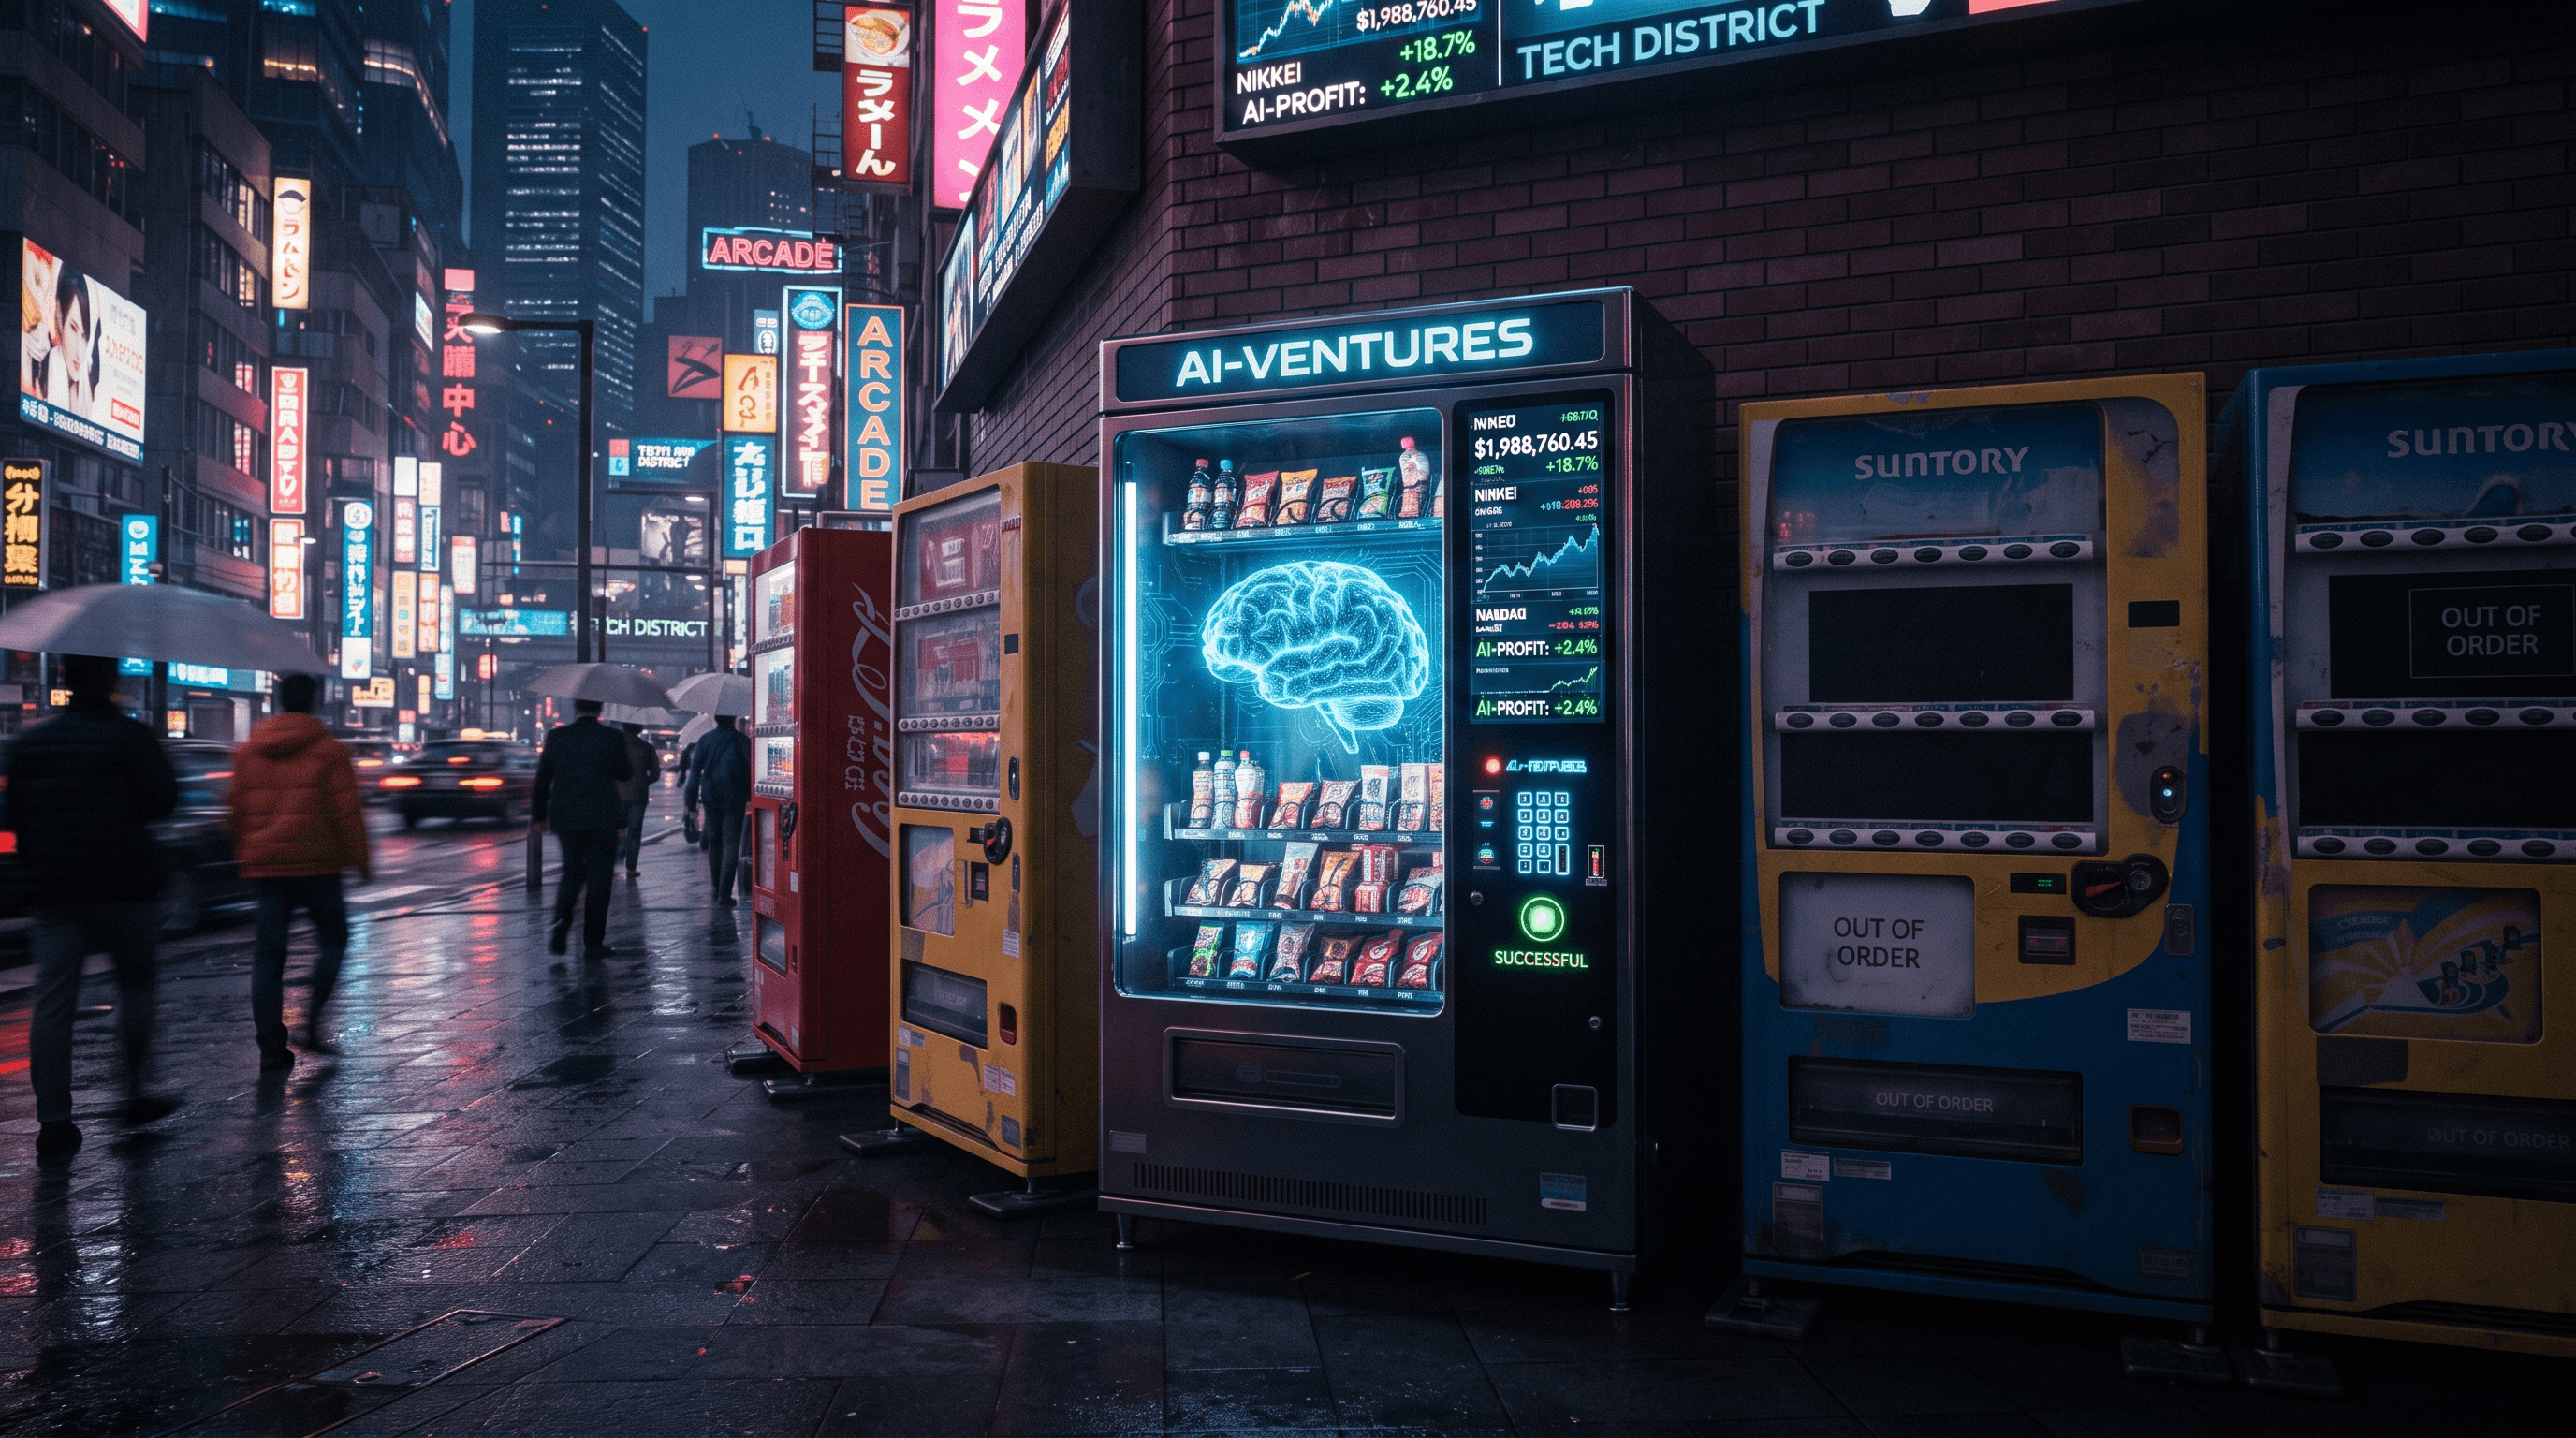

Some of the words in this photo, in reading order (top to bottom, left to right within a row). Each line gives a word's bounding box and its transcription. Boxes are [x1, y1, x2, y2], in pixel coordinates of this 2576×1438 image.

[1356, 0, 1477, 32] $1,988,760.45
[1399, 29, 1476, 63] +18.7%
[1516, 31, 1622, 81] TECH
[1633, 0, 1826, 62] DISTRICT
[1237, 62, 1301, 94] NIKKEI
[1242, 81, 1367, 125] AI-PROFIT:
[1380, 66, 1454, 99] +2.4%
[856, 69, 896, 176] ラメーん
[709, 236, 834, 269] ARCADE
[1176, 318, 1534, 387] AI-VENTURES
[856, 316, 893, 510] ARCADE
[1474, 431, 1598, 460] $1,988,760.45
[1546, 455, 1599, 473] +18.7%
[1854, 446, 2030, 481] SUNTORY
[634, 619, 708, 637] DISTRICT
[2441, 607, 2499, 628] OUT
[2505, 605, 2541, 626] OF
[1476, 640, 1550, 657] AI-PROFIT:
[1554, 638, 1598, 655] +2.4%
[2446, 634, 2539, 656] ORDER
[1476, 700, 1550, 716] AI-PROFIT:
[1554, 699, 1598, 715] +2.4%
[1833, 917, 1885, 939] OUT
[1891, 918, 1925, 940] OF
[1494, 950, 1588, 968] SUCCESSFUL
[1837, 946, 1921, 969] ORDER
[1876, 1092, 1910, 1108] OUT
[1913, 1093, 1935, 1109] OF
[1938, 1094, 1994, 1113] ORDER
[2426, 1127, 2468, 1144] OUT
[2473, 1130, 2498, 1145] OF
[2503, 1131, 2571, 1151] ORDER
